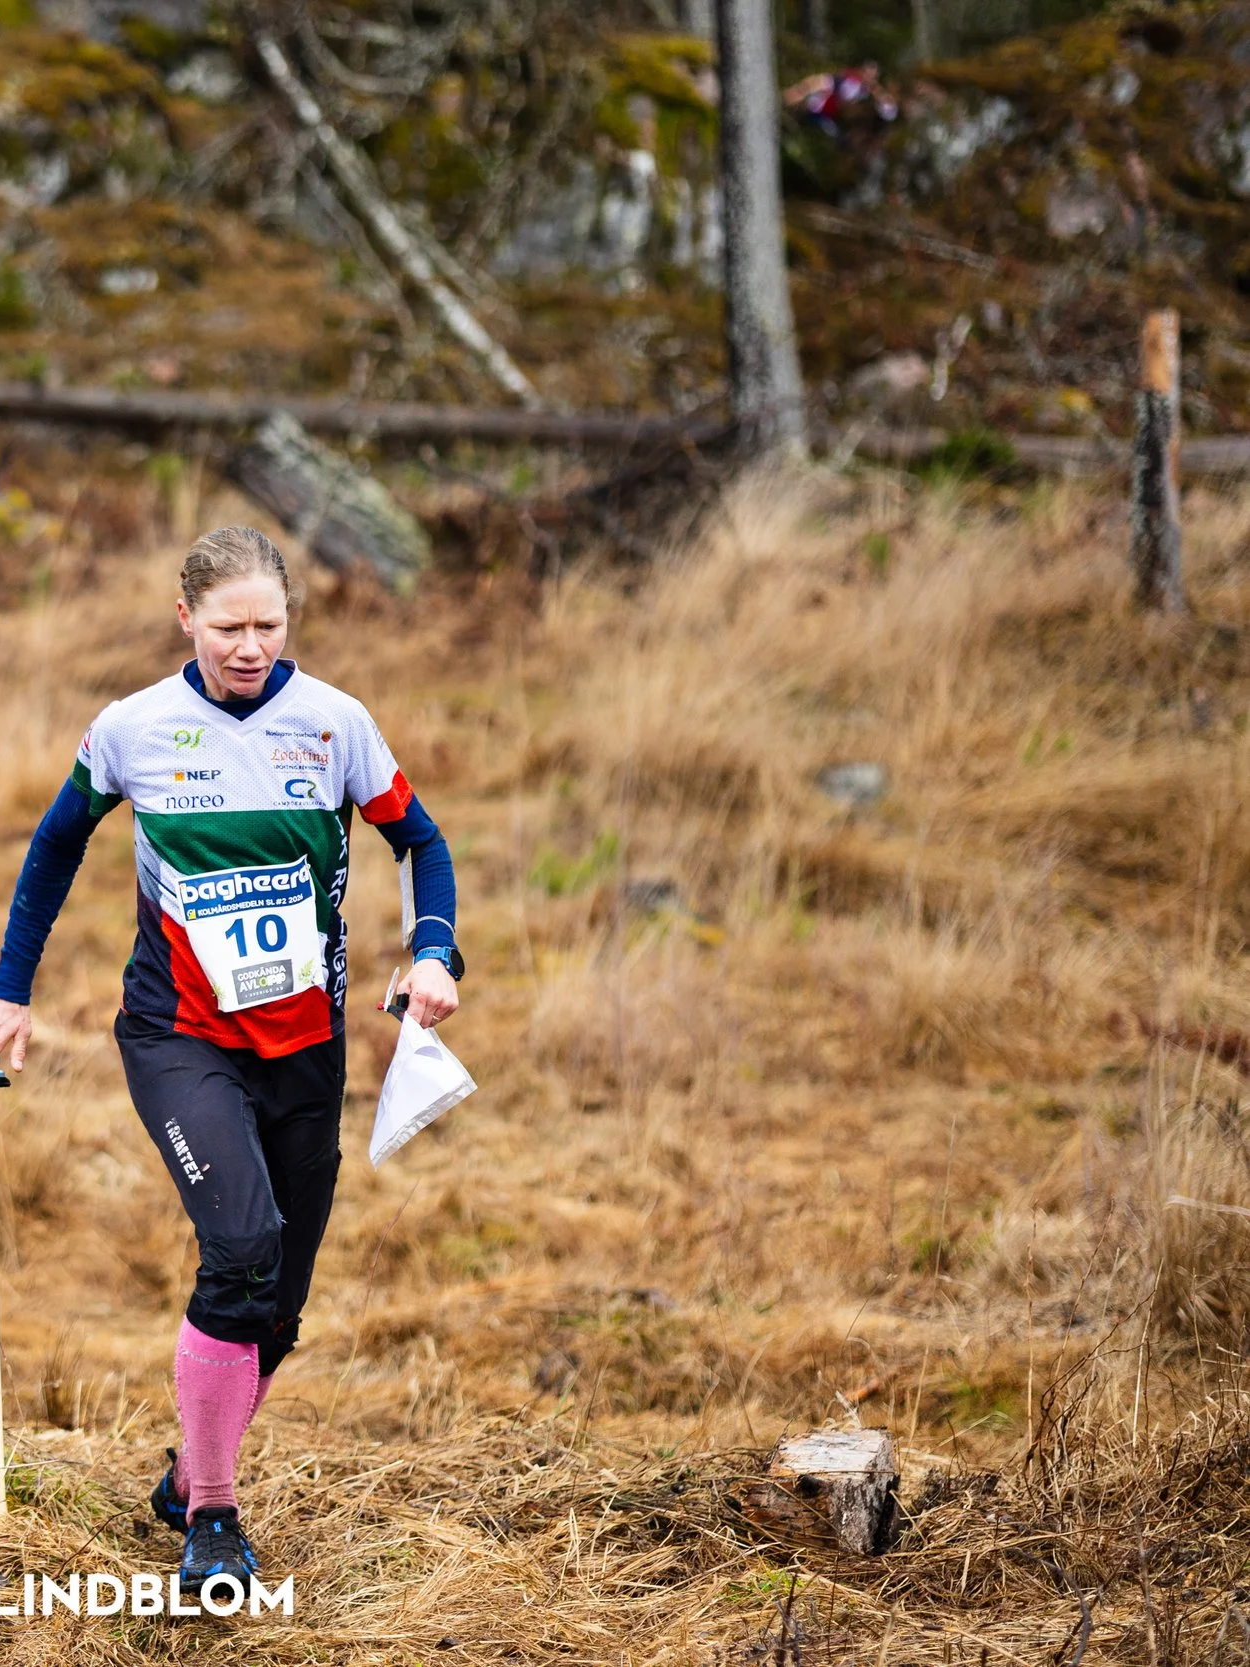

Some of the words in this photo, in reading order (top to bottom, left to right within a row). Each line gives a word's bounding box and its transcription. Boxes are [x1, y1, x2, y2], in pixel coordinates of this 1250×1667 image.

[271, 747, 328, 766] Lochting
[187, 769, 221, 781] NEP
[284, 778, 317, 799] CR
[166, 794, 225, 809] noreo
[180, 866, 310, 905] bagheera
[265, 898, 275, 906] SL
[276, 897, 287, 905] #2
[224, 913, 288, 959] 10
[237, 964, 287, 982] GODKÄNDA
[239, 972, 287, 993] AVLOPP
[164, 1116, 204, 1185] TRIMTEX
